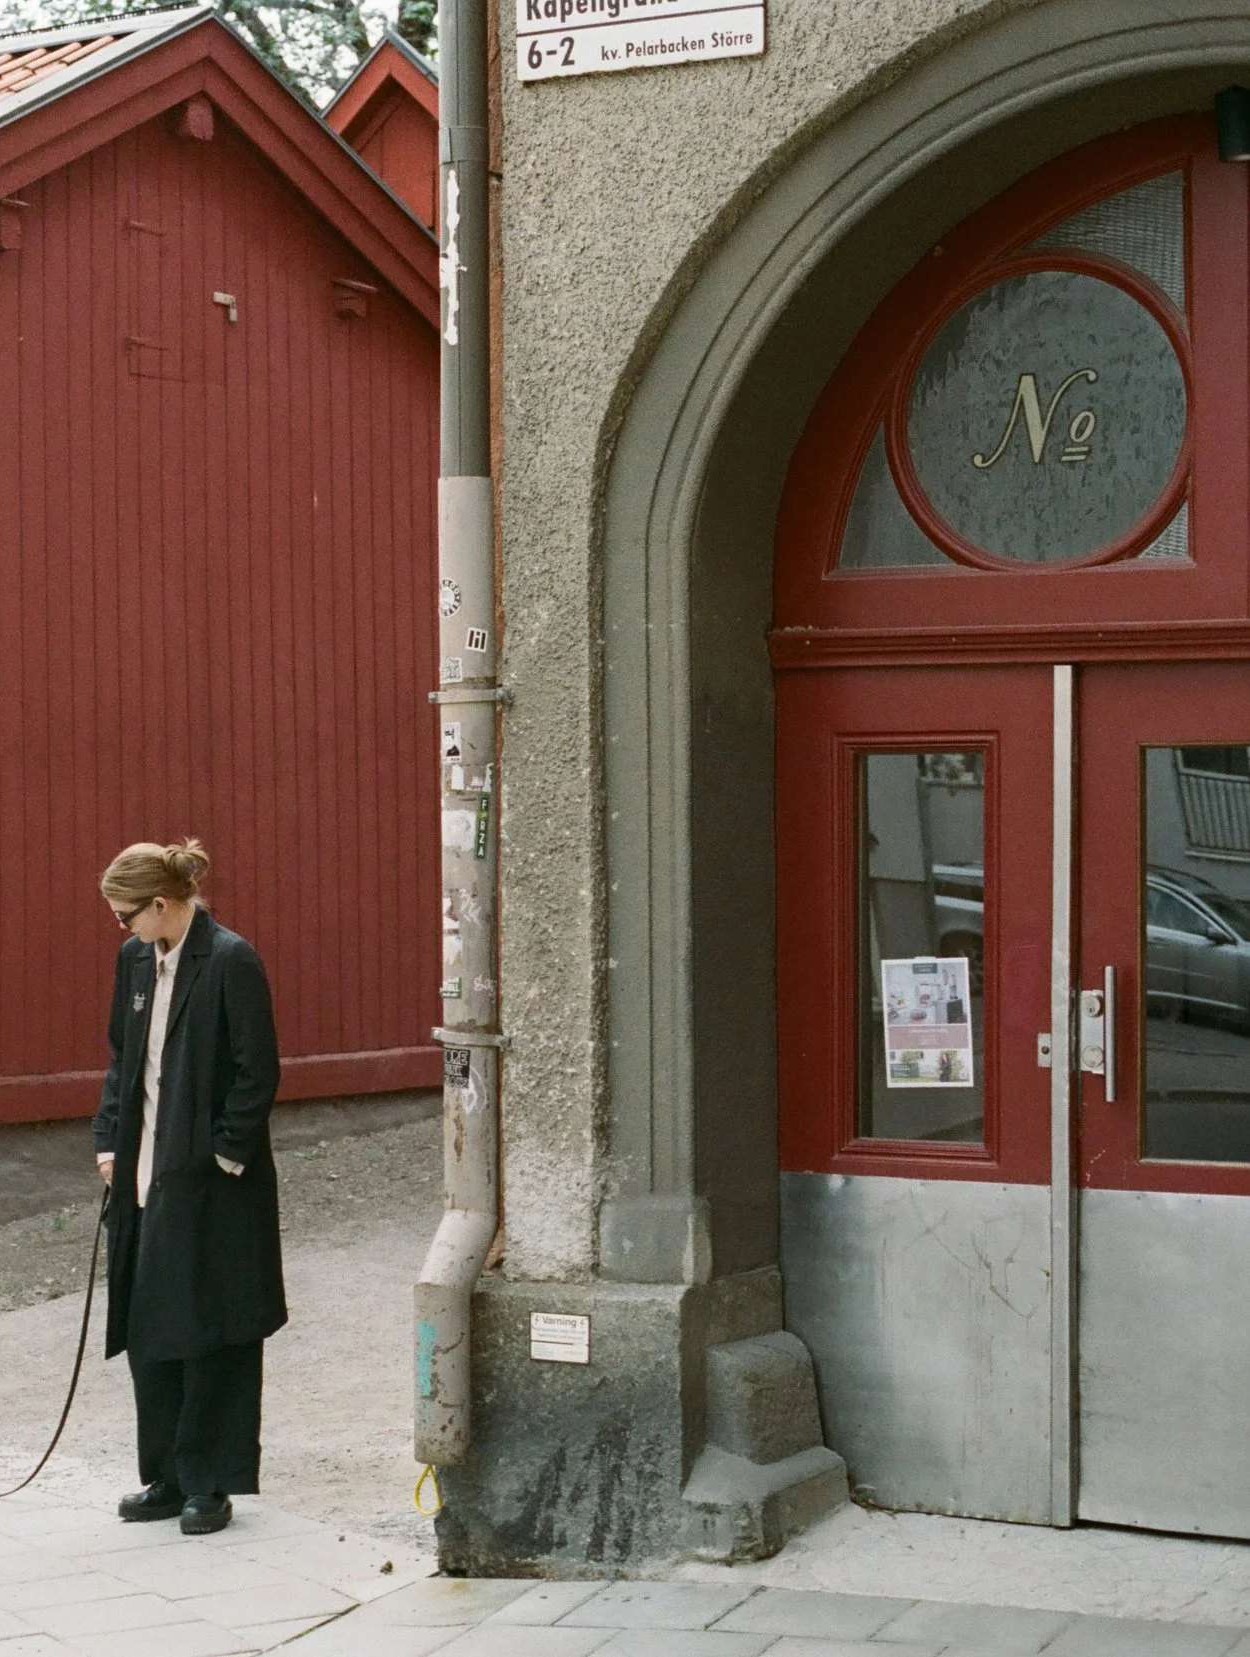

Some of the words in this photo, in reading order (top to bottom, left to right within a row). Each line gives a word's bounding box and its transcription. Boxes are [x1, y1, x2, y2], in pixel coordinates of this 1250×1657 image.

[527, 36, 575, 69] 6-2
[601, 45, 621, 61] kv.
[626, 35, 705, 58] Pelarbacken
[711, 31, 753, 48] Större
